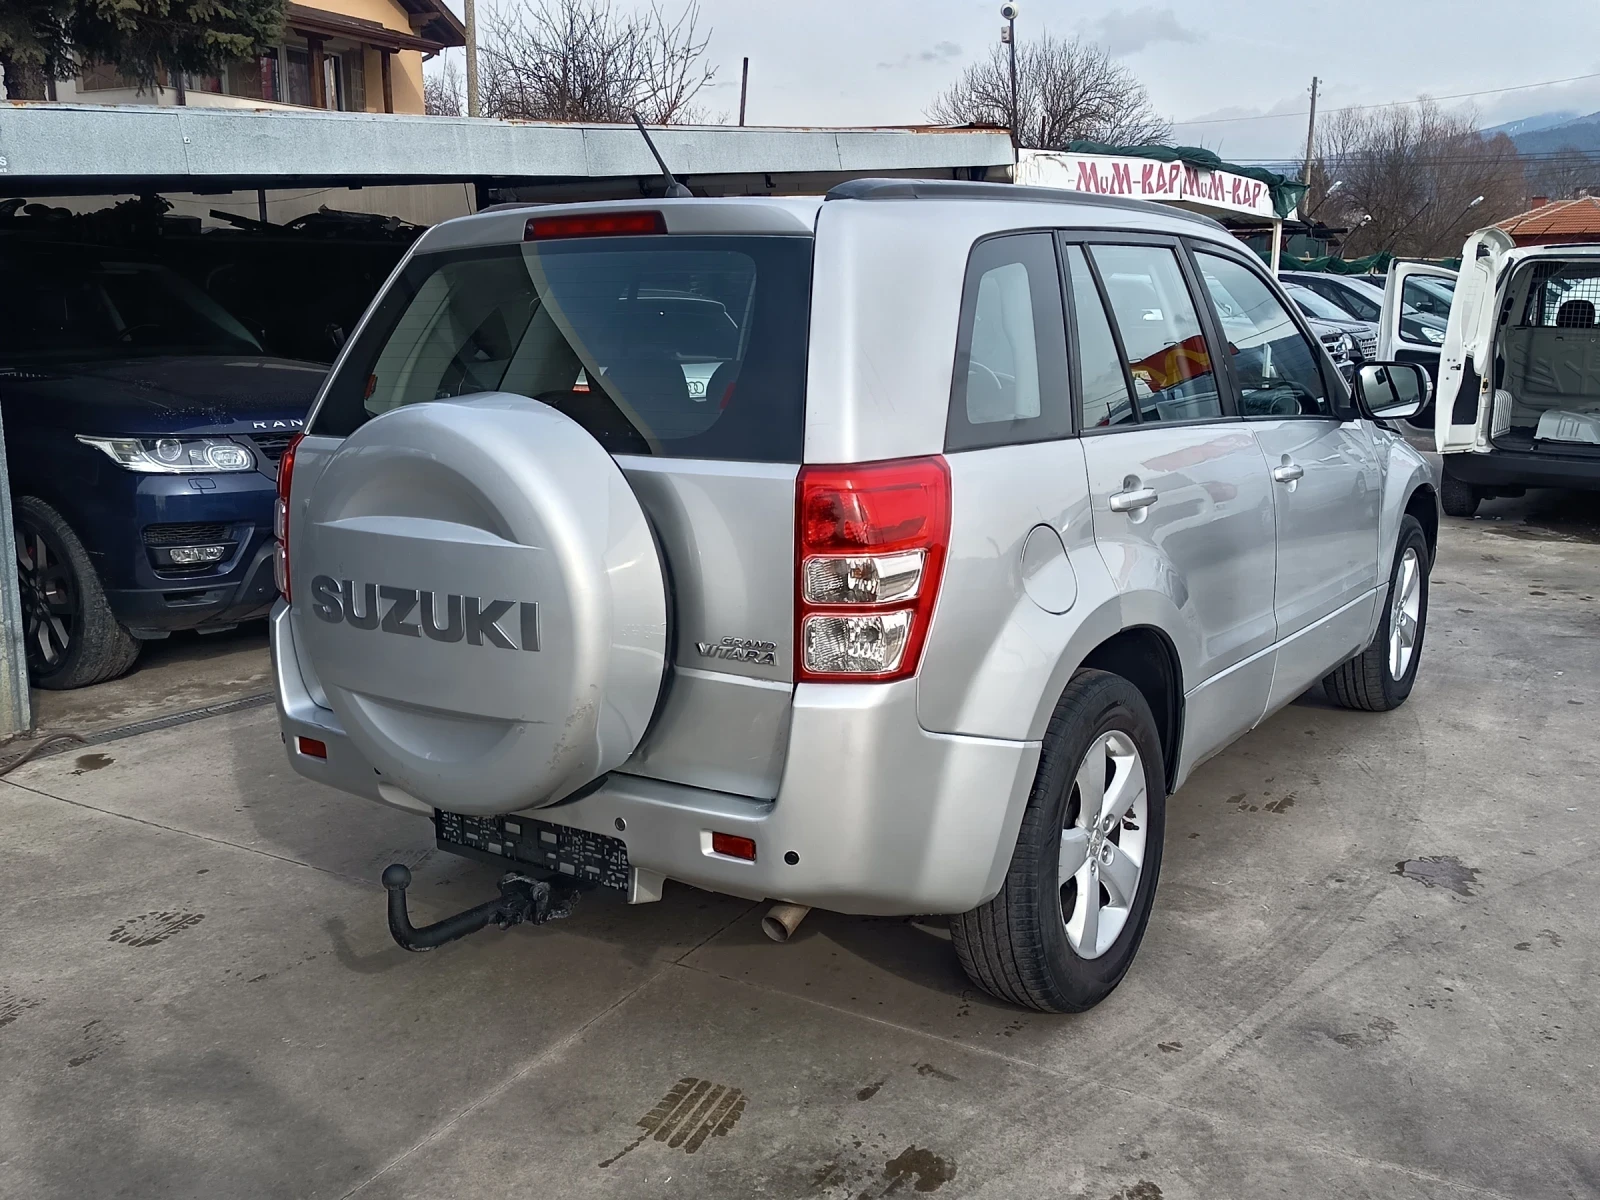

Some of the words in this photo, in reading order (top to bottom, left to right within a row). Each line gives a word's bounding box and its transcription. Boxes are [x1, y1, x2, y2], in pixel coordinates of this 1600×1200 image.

[310, 574, 542, 653] SUZUKI
[694, 641, 778, 667] VITARA
[720, 635, 778, 652] GRAND
